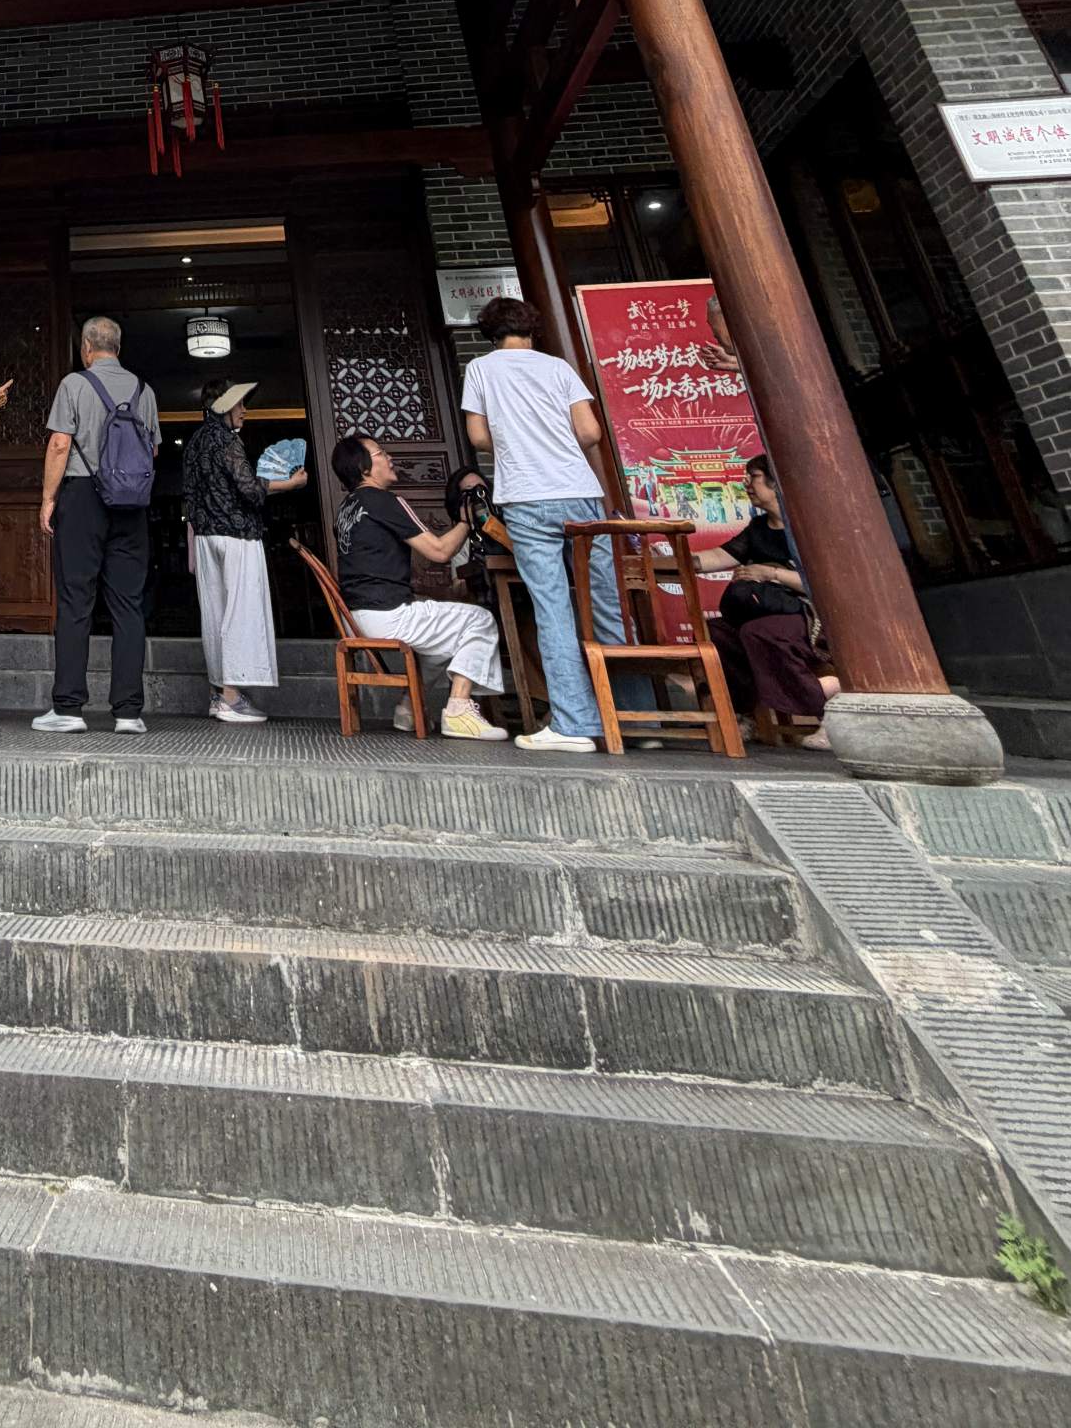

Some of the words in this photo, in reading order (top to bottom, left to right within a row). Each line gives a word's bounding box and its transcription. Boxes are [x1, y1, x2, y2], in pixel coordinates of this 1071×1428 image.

[971, 124, 1070, 146] 文明诚信个体
